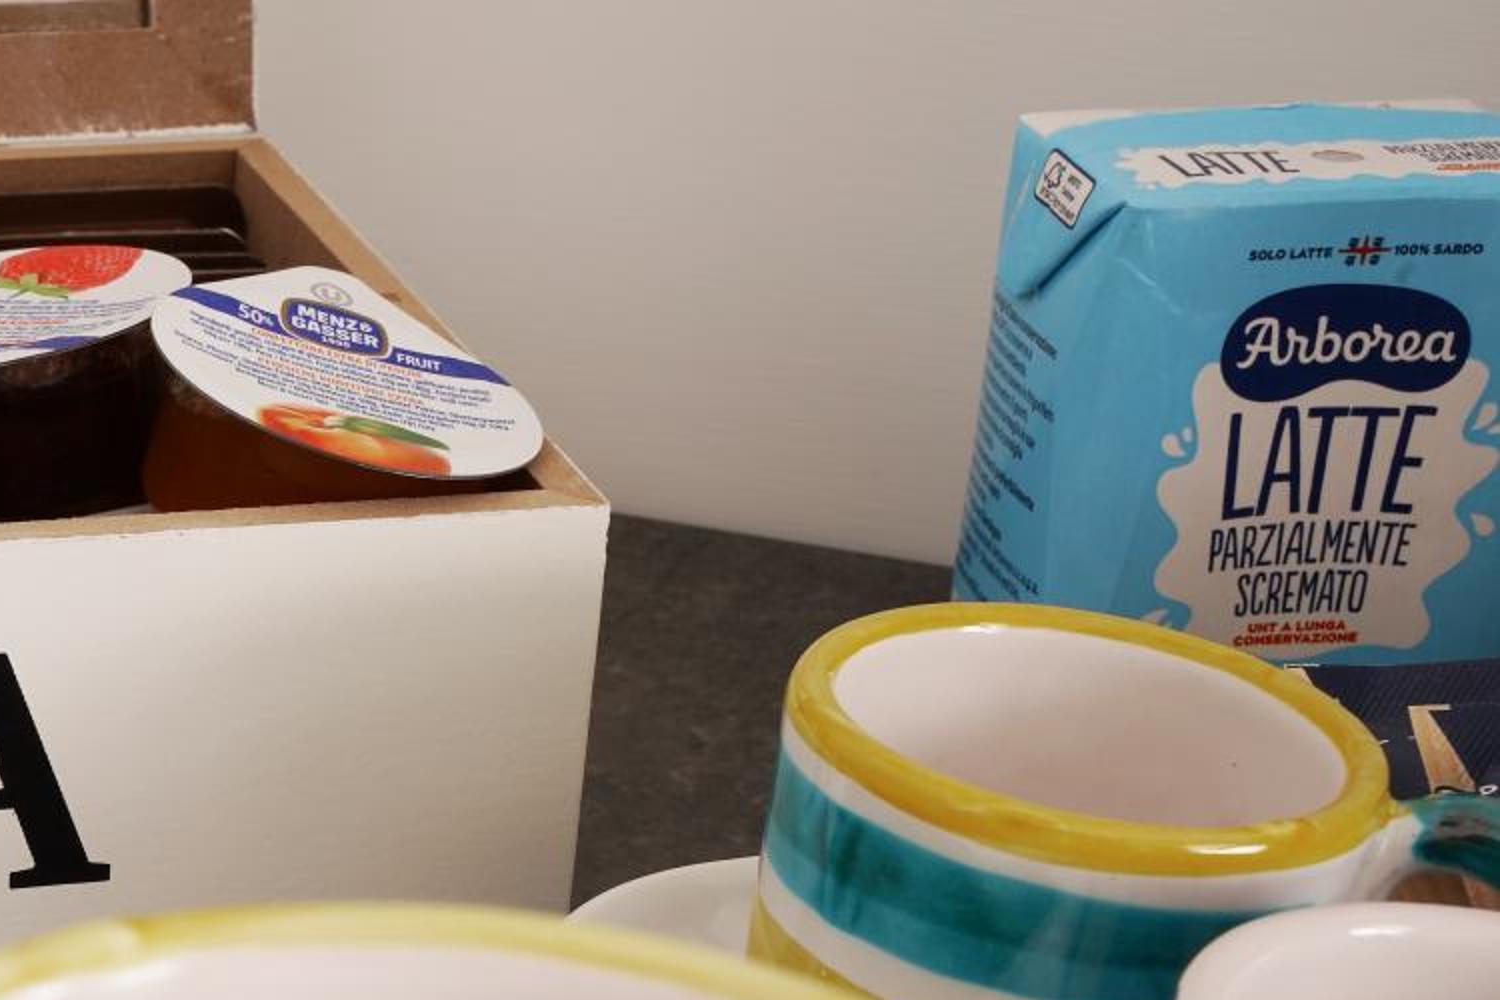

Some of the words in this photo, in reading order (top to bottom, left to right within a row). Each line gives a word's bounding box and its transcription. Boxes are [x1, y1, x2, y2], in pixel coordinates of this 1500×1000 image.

[1159, 150, 1301, 179] LATTE
[1248, 250, 1285, 262] SOLO
[1289, 247, 1333, 260] LATTE
[1394, 244, 1431, 257] 100%
[1432, 242, 1484, 256] SARDO
[237, 303, 275, 328] 50%
[290, 315, 380, 350] GASSER
[1235, 316, 1458, 371] Arborea
[395, 353, 444, 373] FRUIT
[1221, 404, 1438, 520] LATTE
[1207, 521, 1417, 574] PARZIALMENTE
[1233, 569, 1370, 618] SCREMATO
[1295, 619, 1347, 631] LUNGA
[1232, 631, 1358, 647] CONSERVAZIONE
